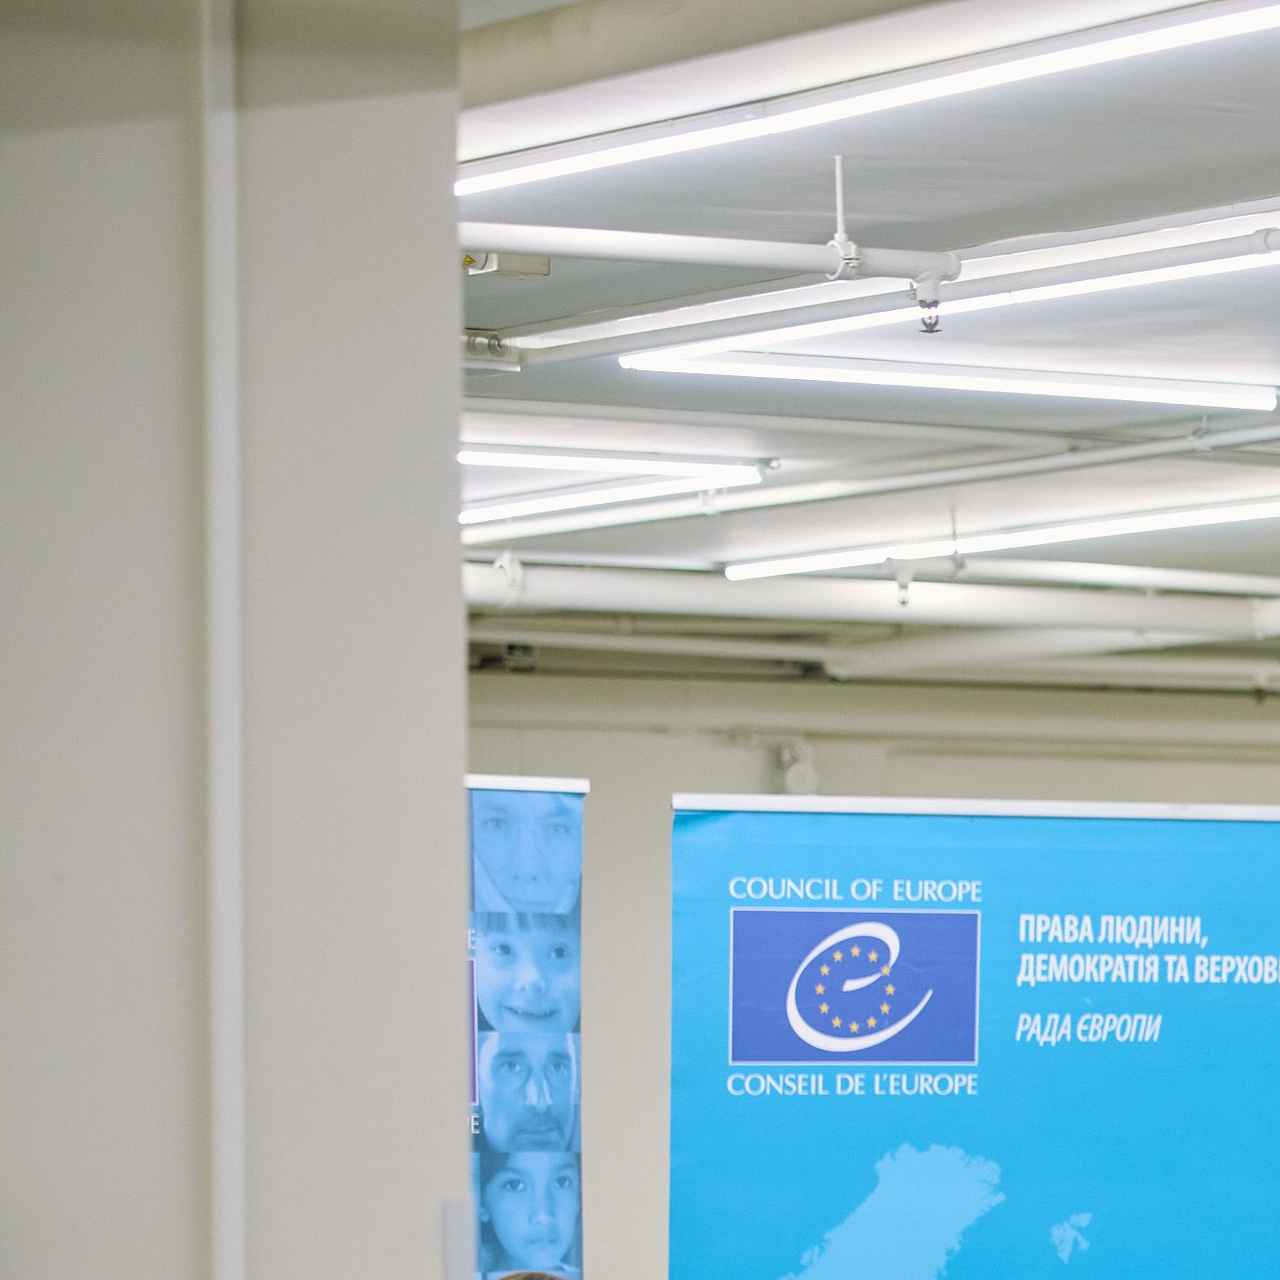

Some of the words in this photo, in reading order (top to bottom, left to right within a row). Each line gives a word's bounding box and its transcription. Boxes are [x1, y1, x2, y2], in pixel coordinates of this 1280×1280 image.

[728, 876, 843, 900] COUNCIL
[850, 878, 884, 901] OF
[893, 880, 982, 903] EUROPE
[1018, 913, 1094, 943] ПРАВА
[1097, 914, 1209, 949] ЛЮДИНИ,
[1016, 953, 1160, 987] ДЕМОКРАТІЯ
[1164, 954, 1189, 983] ТА
[1015, 1013, 1072, 1047] РАДА
[1076, 1013, 1163, 1043] ЄВРОПИ
[727, 1072, 829, 1096] CONSEIL
[836, 1073, 867, 1096] DE
[874, 1073, 978, 1096] L'EUROPE
